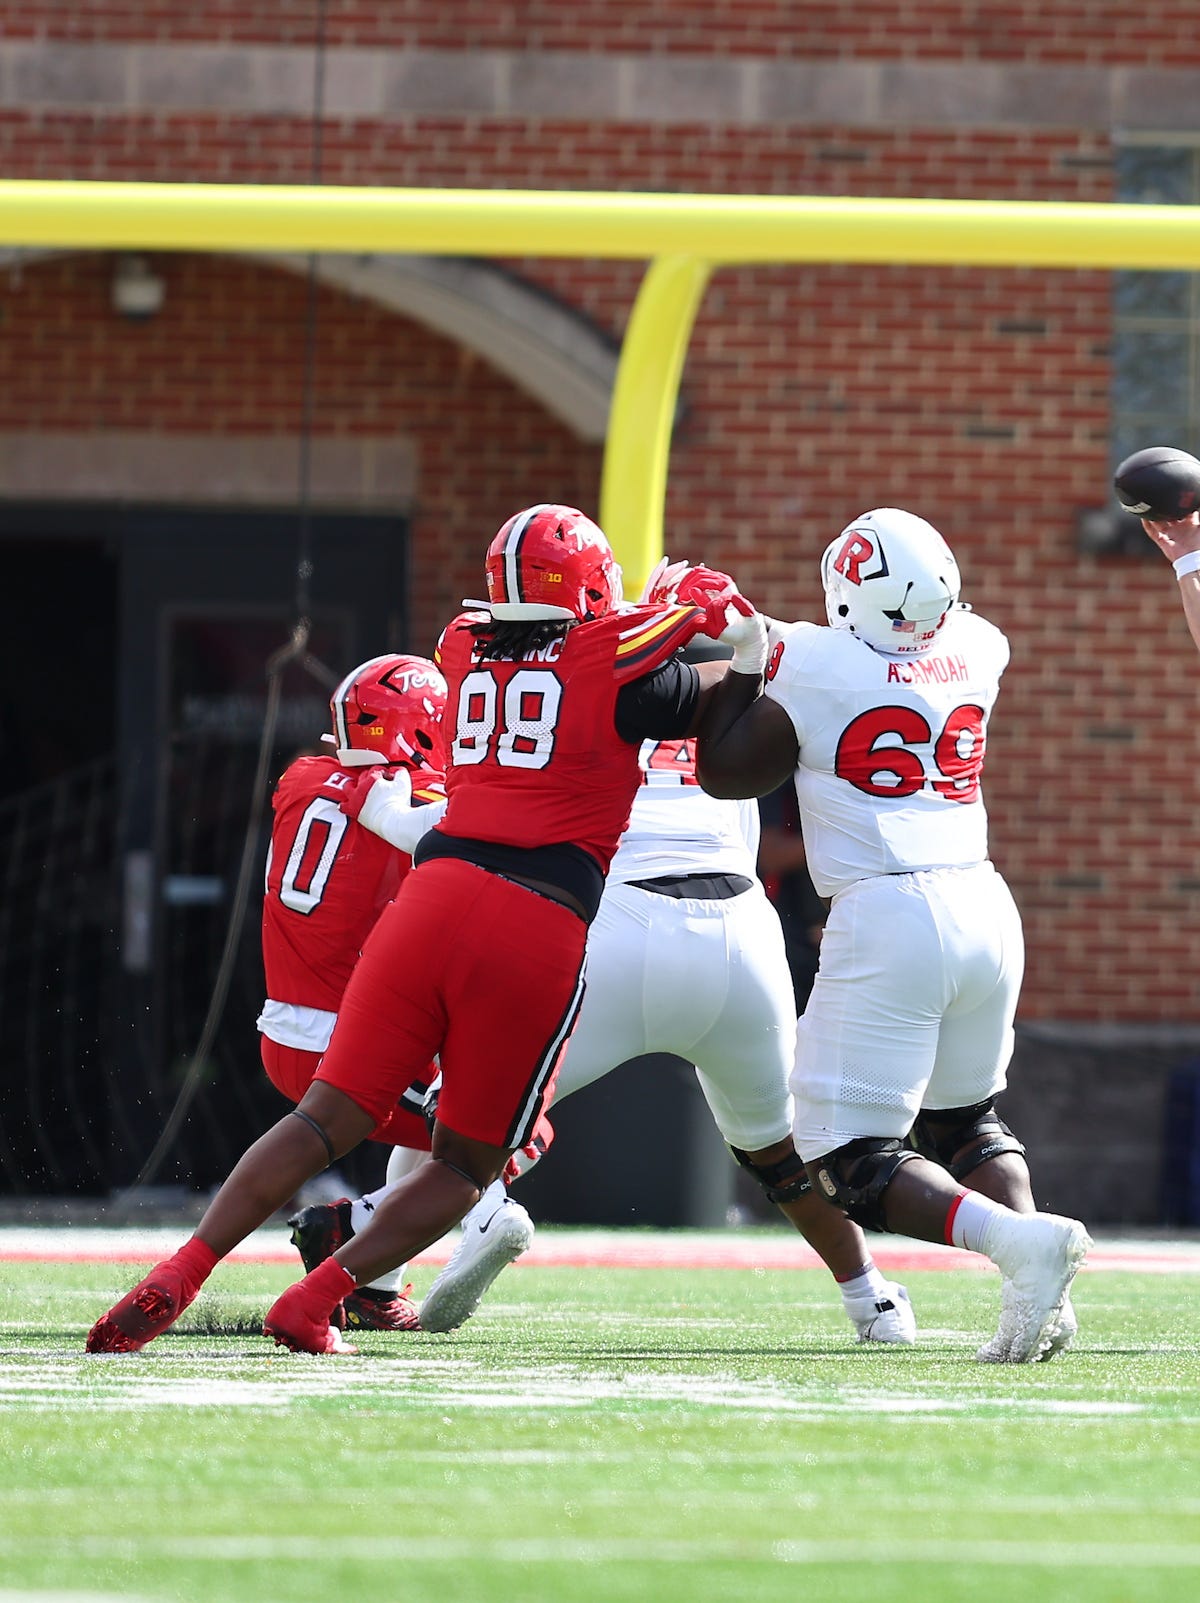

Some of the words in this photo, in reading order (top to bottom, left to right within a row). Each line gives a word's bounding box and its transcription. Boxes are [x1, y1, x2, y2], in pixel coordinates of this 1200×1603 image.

[834, 531, 873, 586] R
[450, 668, 565, 770] 88
[835, 704, 986, 804] 69
[279, 795, 350, 917] 0
